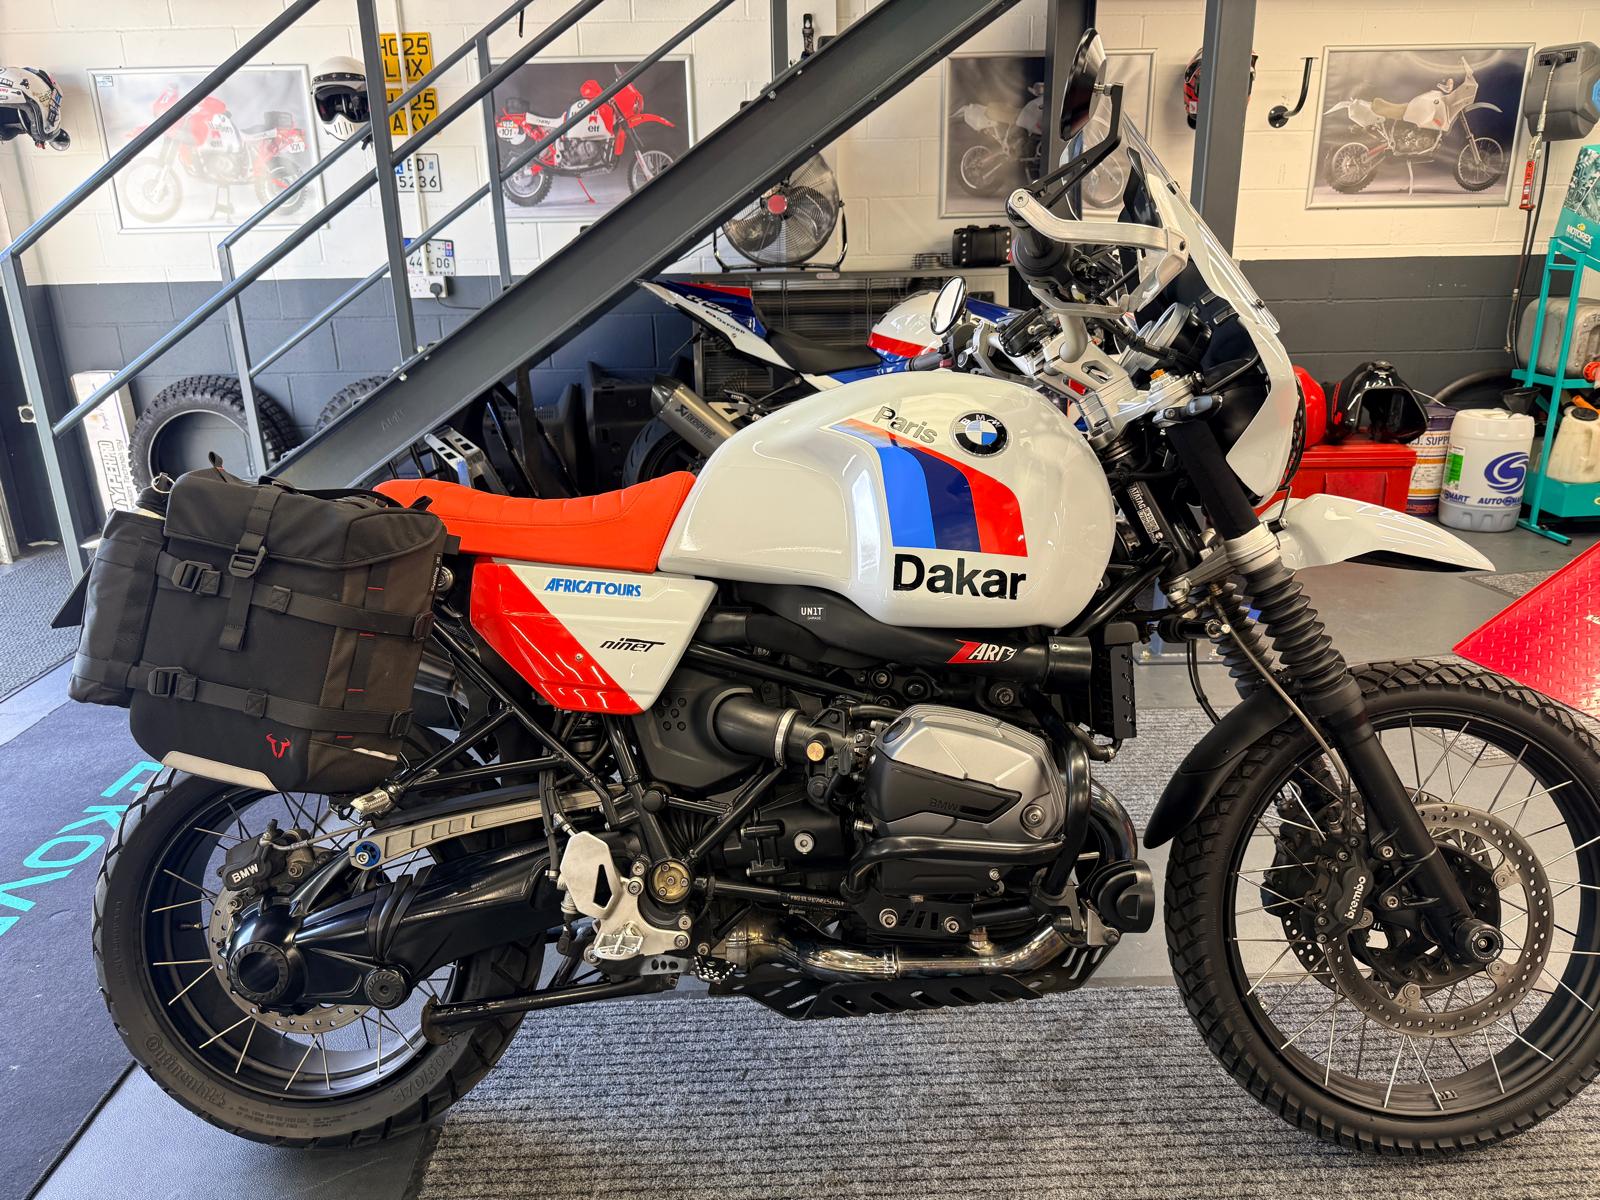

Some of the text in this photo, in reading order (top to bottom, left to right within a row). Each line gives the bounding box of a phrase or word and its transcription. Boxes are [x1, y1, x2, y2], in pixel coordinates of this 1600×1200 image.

[872, 405, 938, 444] Paris
[960, 413, 1002, 428] BMW
[893, 553, 1027, 600] Dakar
[544, 577, 641, 597] AFRICATOURS
[599, 637, 666, 653] nineT
[929, 797, 960, 812] BMW
[231, 863, 259, 883] BMW
[1344, 875, 1367, 920] brembo
